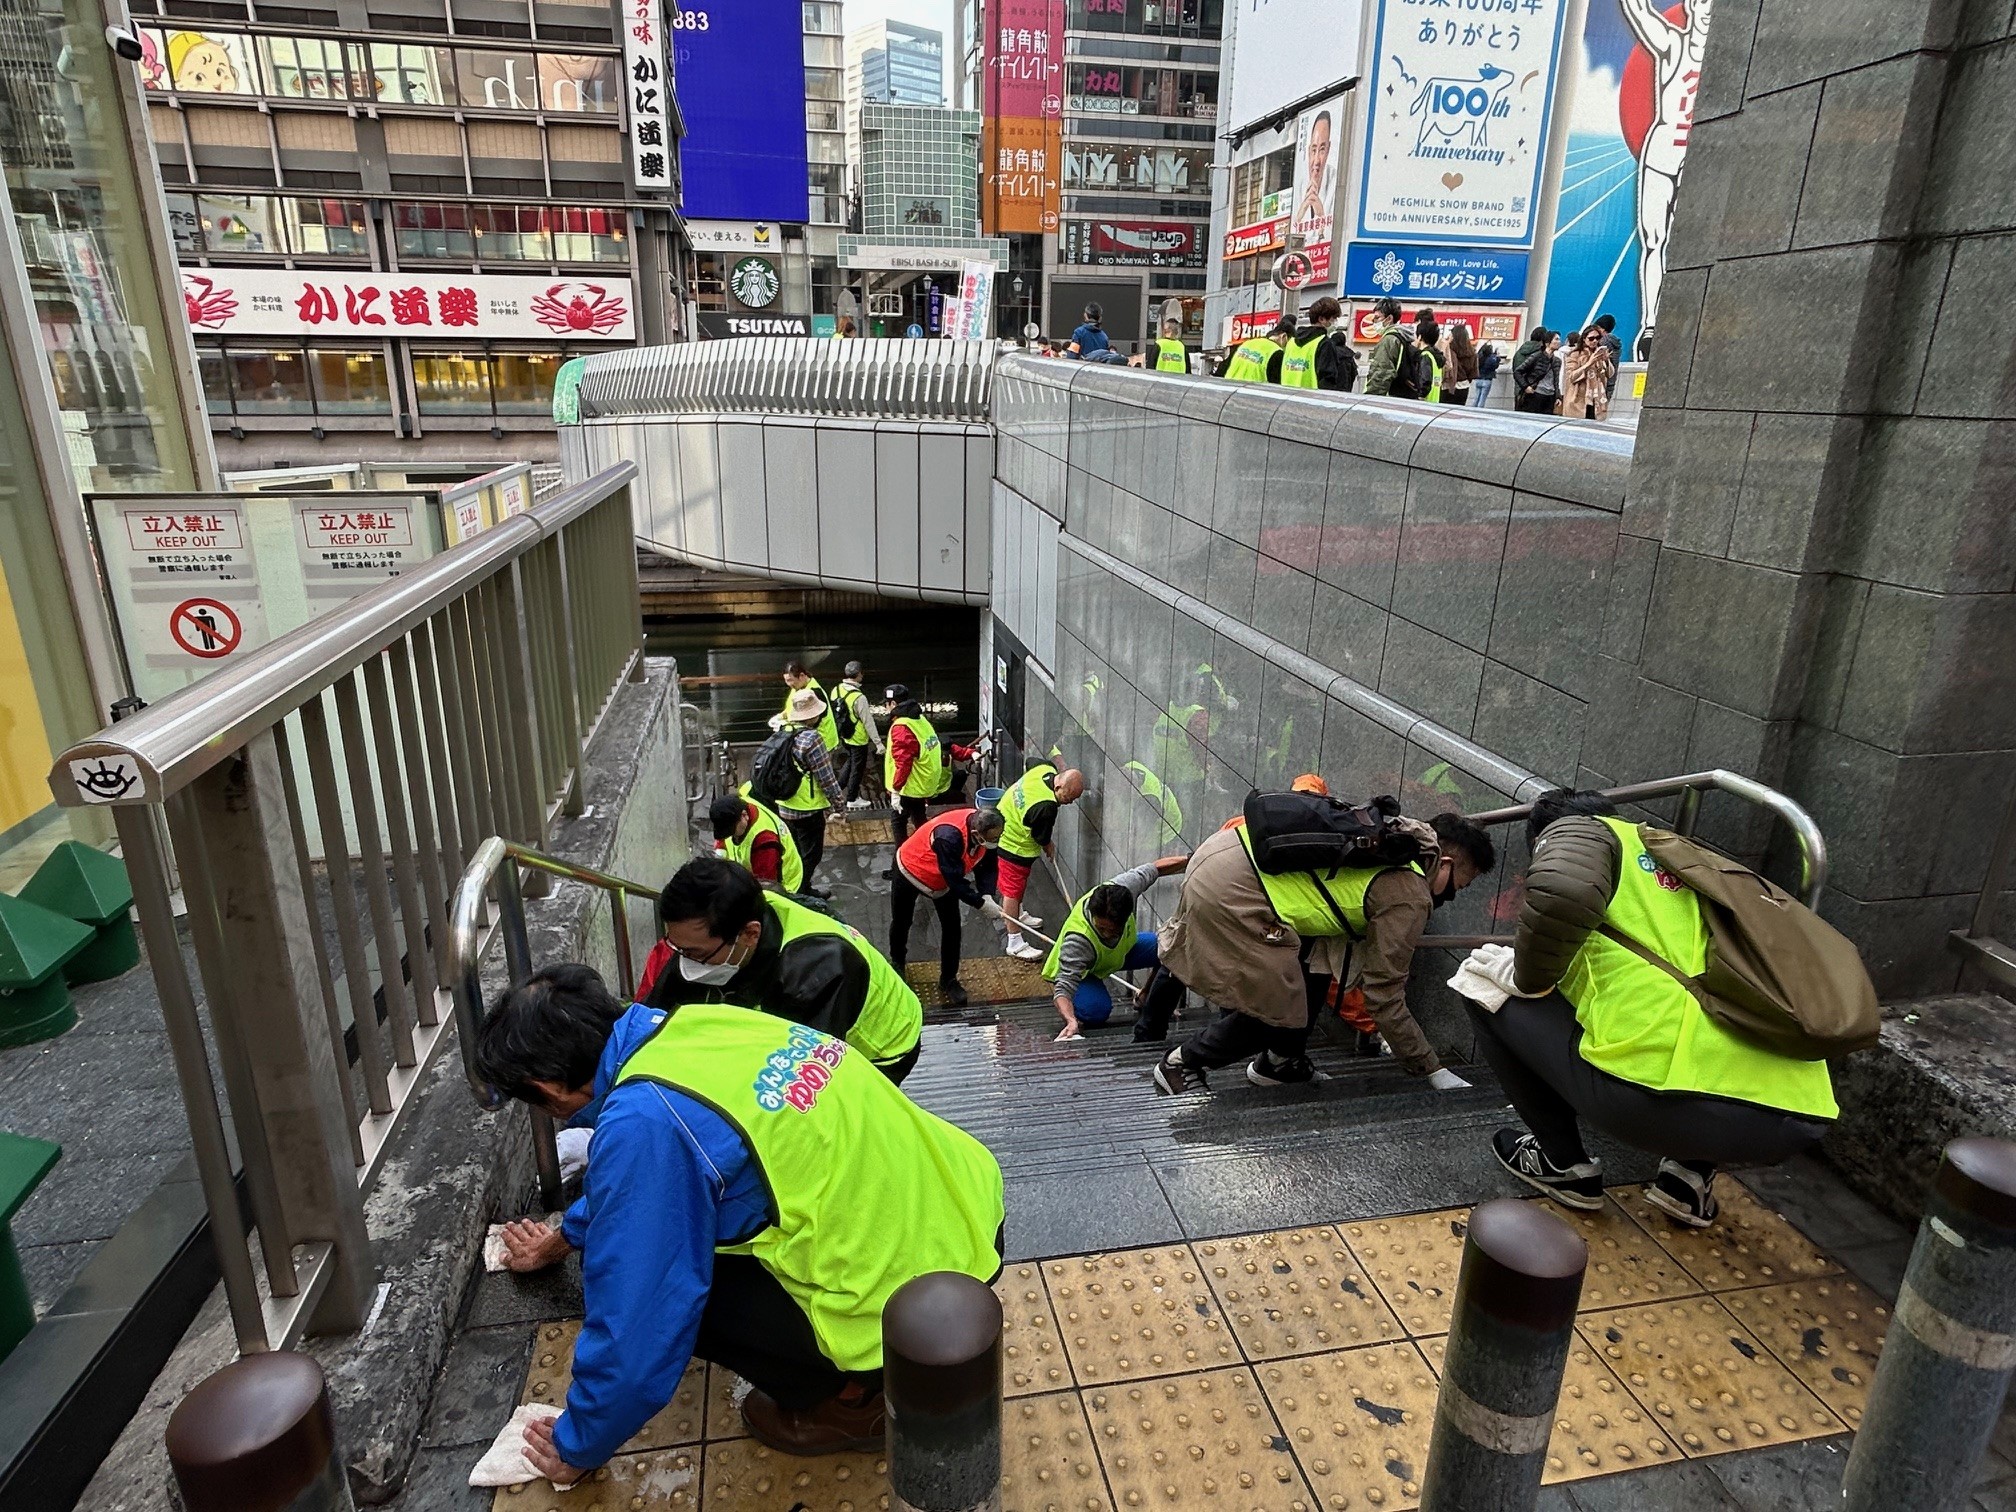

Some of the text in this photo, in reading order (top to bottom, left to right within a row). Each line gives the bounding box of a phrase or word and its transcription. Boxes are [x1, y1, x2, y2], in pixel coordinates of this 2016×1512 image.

[1418, 17, 1520, 51] ありがとう
[1407, 142, 1505, 167] Anniversary
[1392, 197, 1504, 212] MEGMILK SNOW BRAND
[1372, 212, 1397, 223] 100th
[1235, 232, 1272, 254] ZETTERIA
[1415, 256, 1500, 269] Love Earth. Love Life.
[1408, 270, 1504, 293] 雪印メグミルク
[726, 318, 806, 334] TSUTAYA
[142, 515, 225, 533] 立入禁止
[318, 513, 396, 531] 立入禁止
[155, 535, 217, 548] KEEP OUT
[330, 532, 389, 545] KEEP OUT
[148, 554, 233, 564] 無断で立ち入った場合
[321, 550, 402, 561] 無断で立ち入った場合
[158, 564, 226, 573] 警察に通報します
[331, 560, 395, 570] 警察に通報します
[1519, 1146, 1544, 1176] N
